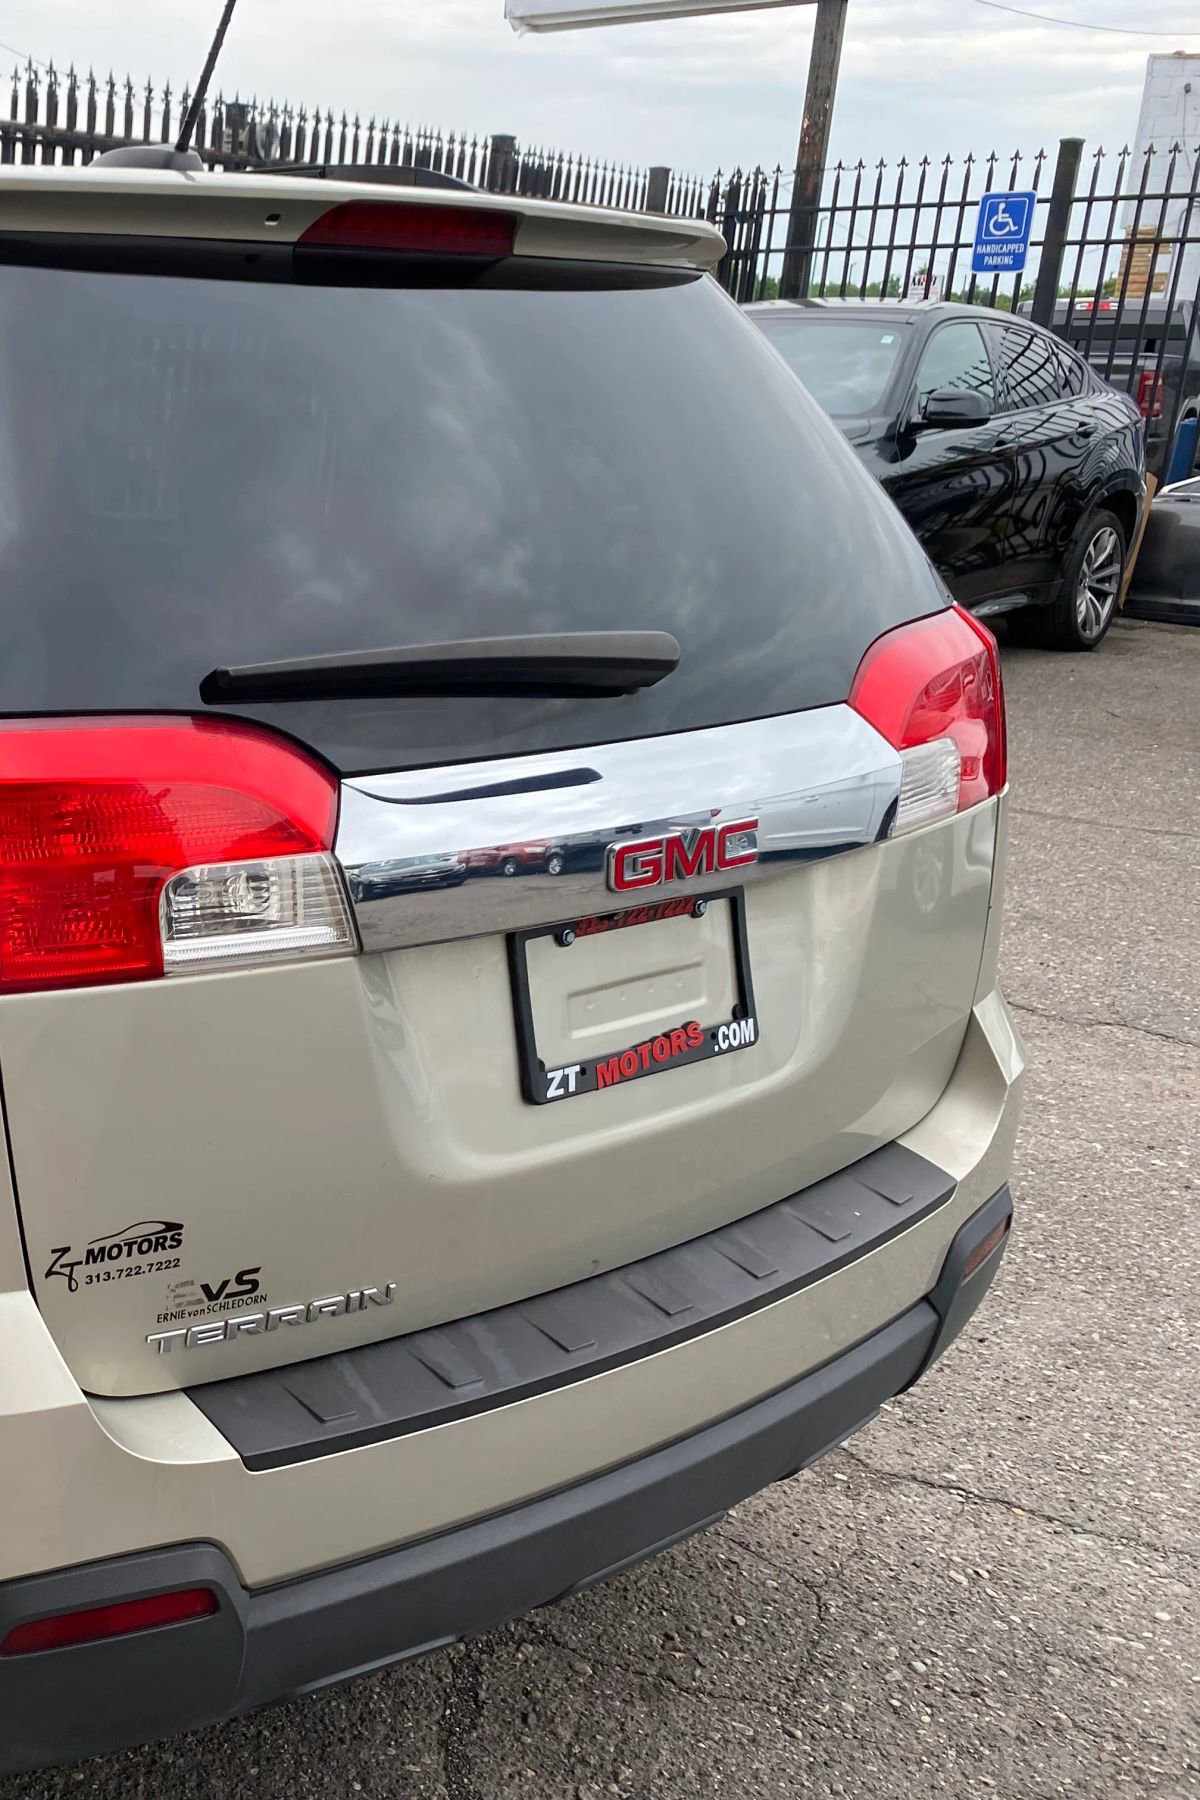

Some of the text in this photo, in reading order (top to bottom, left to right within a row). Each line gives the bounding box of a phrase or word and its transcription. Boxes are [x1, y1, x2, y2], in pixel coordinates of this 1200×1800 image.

[976, 243, 1024, 254] HANDICAPPED
[983, 255, 1014, 266] PARKING
[606, 816, 759, 893] GMC
[546, 1018, 755, 1099] ZT MOTORS .COM
[85, 1231, 183, 1265] MOTORS
[85, 1258, 181, 1285] 313.722.7222
[146, 1282, 397, 1354] TERRAIN
[156, 1308, 187, 1324] ERNIE
